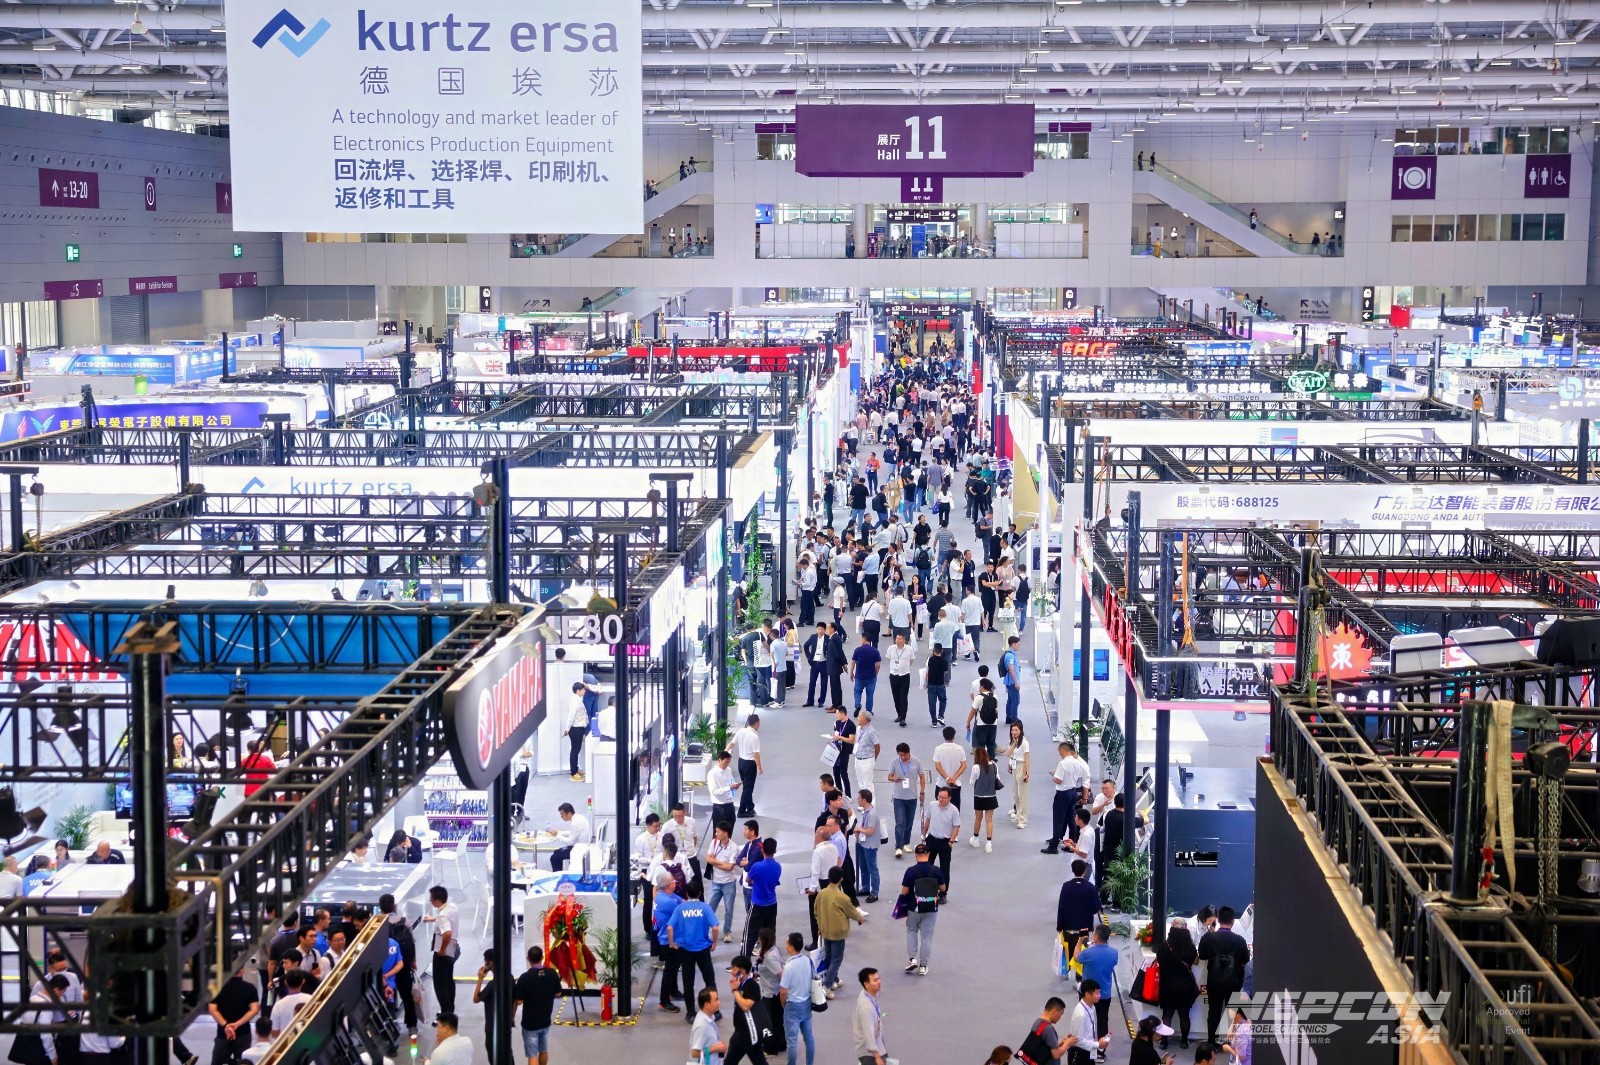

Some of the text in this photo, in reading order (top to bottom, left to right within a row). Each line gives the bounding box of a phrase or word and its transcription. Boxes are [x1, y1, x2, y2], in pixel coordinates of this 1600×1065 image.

[357, 9, 619, 53] kurtz ersa
[360, 65, 619, 97] 德国埃莎
[332, 108, 619, 128] A technology and market leader of
[333, 135, 614, 157] Electronics Production Equipment
[877, 115, 947, 160] Hall 11
[877, 134, 900, 146] 展厅
[334, 158, 610, 184] 回流焊、选择焊、印刷机、
[69, 180, 88, 199] 13-20
[334, 186, 456, 211] 返修和工具
[290, 476, 413, 496] kurtz ersa
[1371, 512, 1429, 521] GUANGDONG
[1432, 512, 1459, 521] ANDA
[493, 641, 542, 751] YAMAHA
[682, 909, 703, 918] WKK
